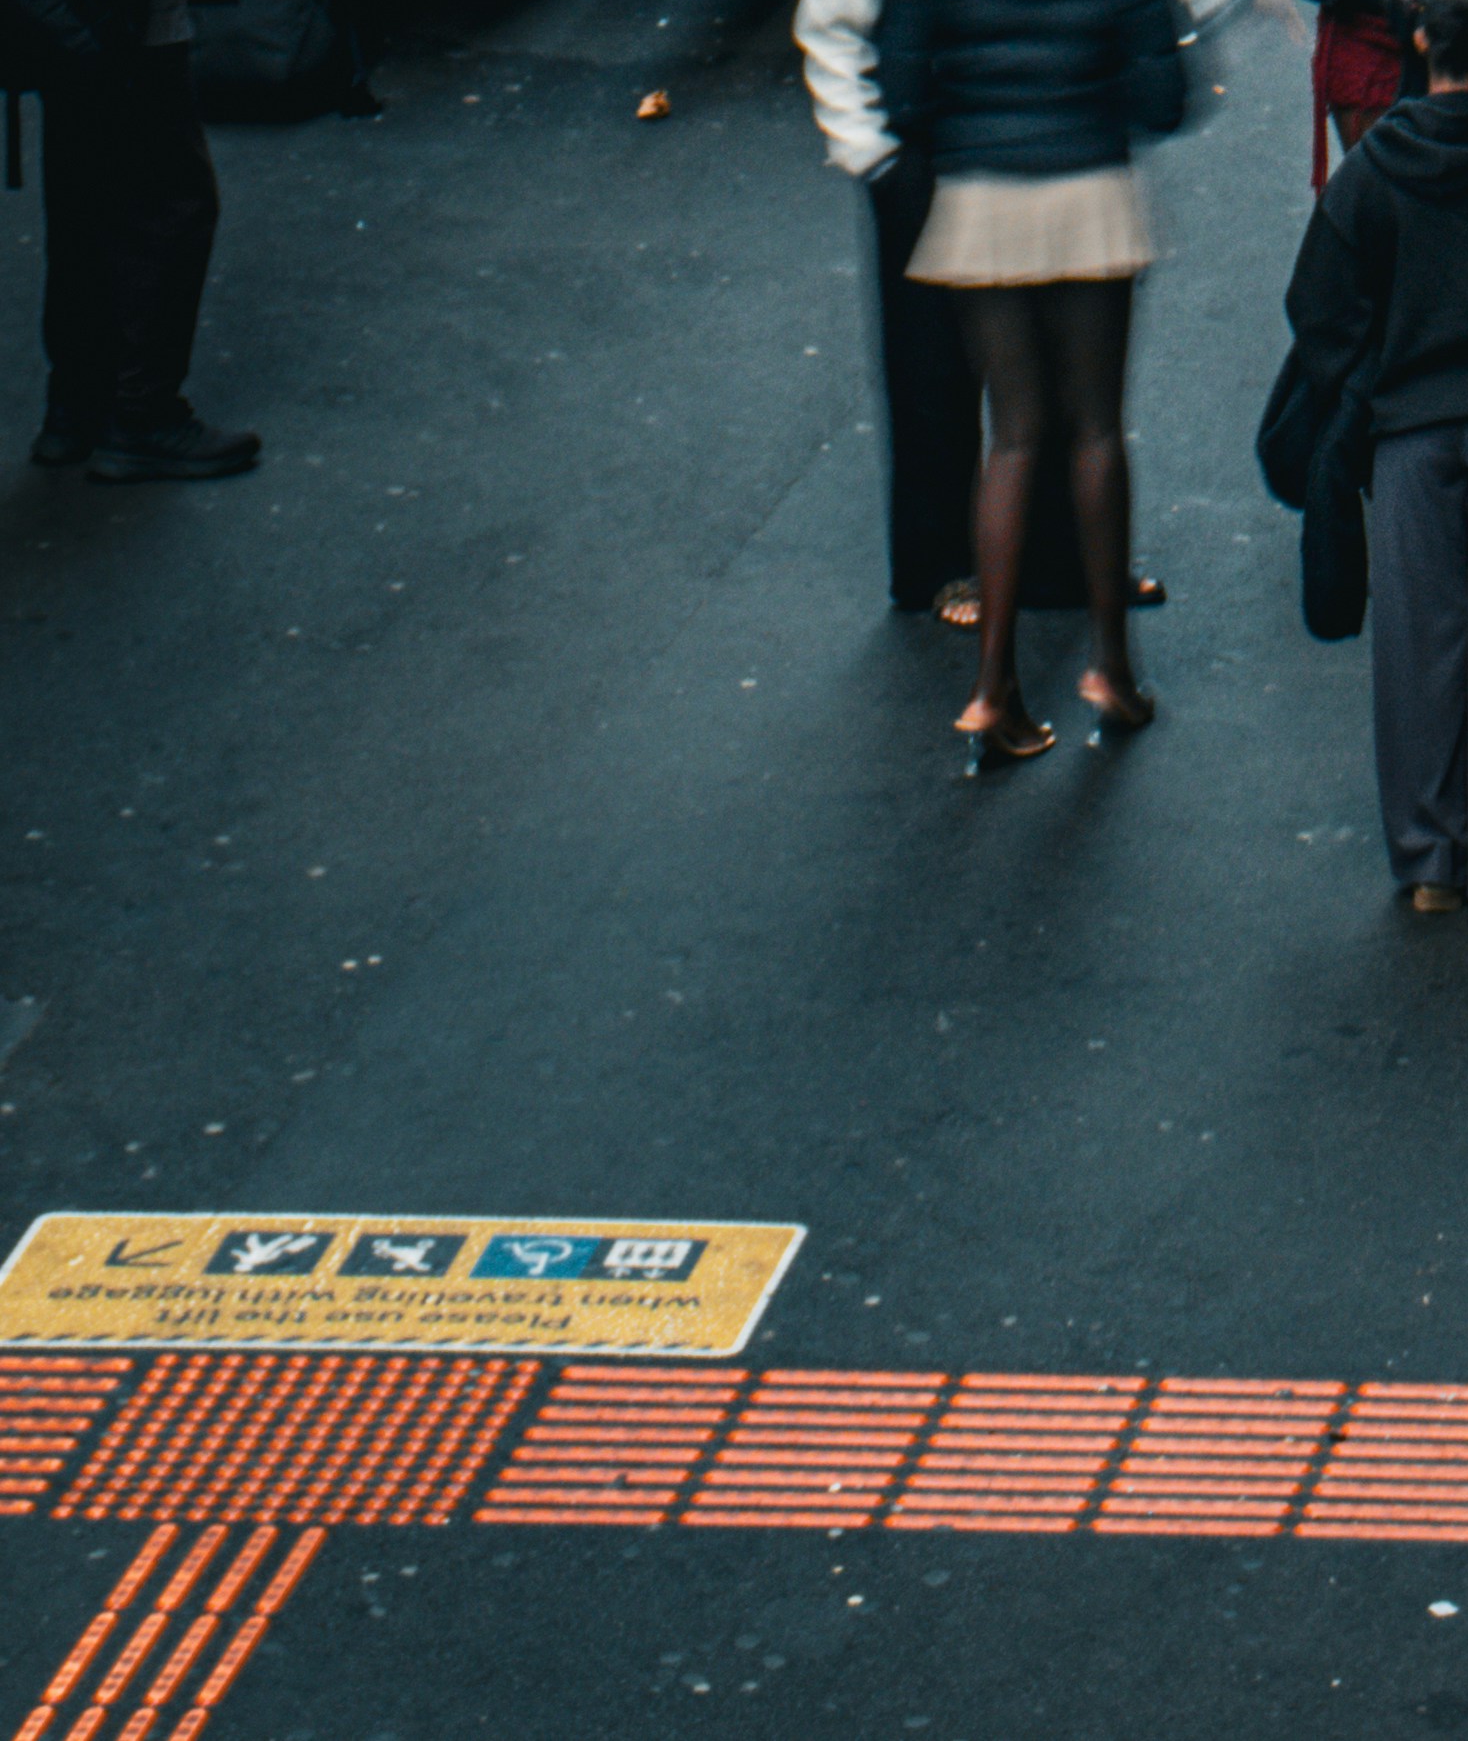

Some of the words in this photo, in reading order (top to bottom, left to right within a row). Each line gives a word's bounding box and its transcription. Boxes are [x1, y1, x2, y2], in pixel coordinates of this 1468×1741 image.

[47, 1283, 226, 1305] luggage
[237, 1288, 336, 1306] with
[351, 1285, 564, 1307] travelling
[580, 1293, 701, 1311] when
[156, 1308, 221, 1326] lift
[235, 1309, 307, 1326] the
[324, 1310, 404, 1324] use
[419, 1312, 573, 1329] Please
